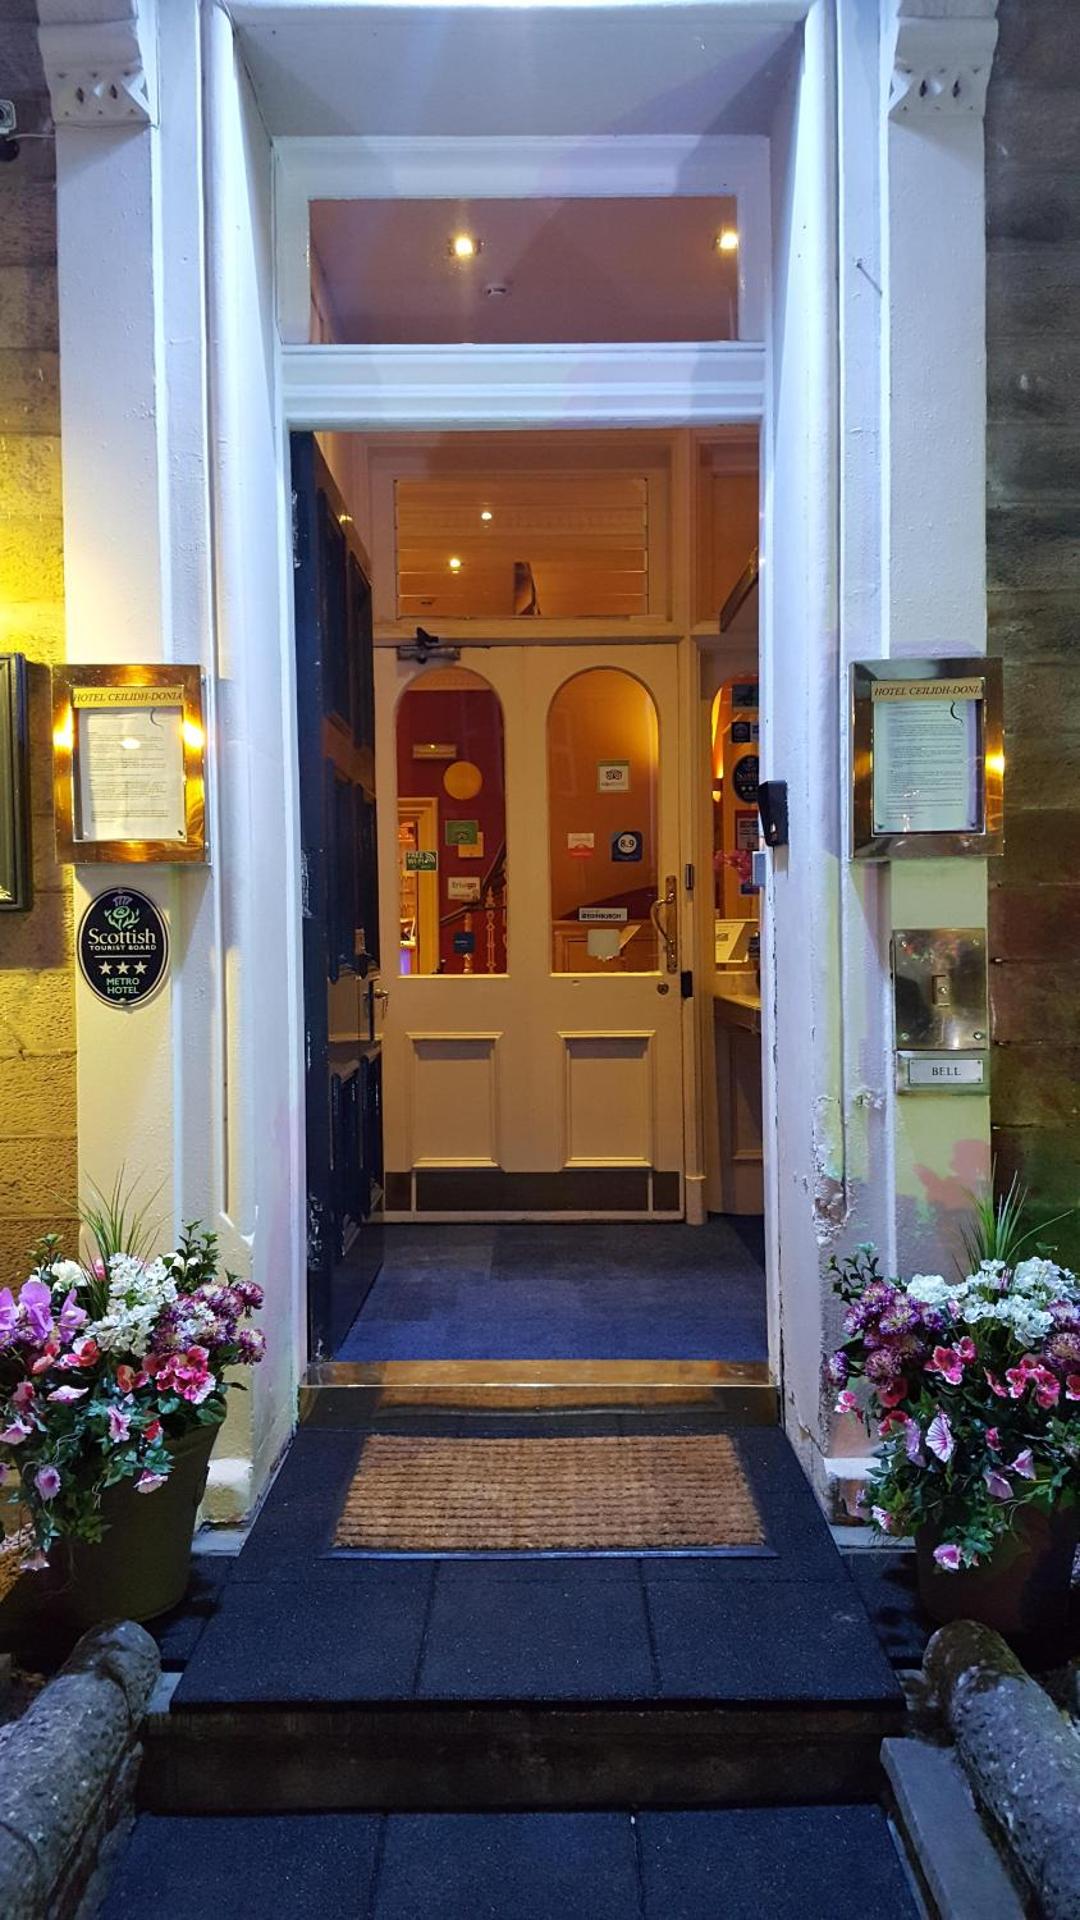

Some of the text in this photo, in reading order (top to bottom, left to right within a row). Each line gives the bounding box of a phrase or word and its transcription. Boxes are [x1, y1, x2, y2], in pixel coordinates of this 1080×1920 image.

[875, 687, 906, 697] HOTEL
[620, 838, 635, 849] 8.9
[87, 927, 156, 945] Scottish
[105, 976, 141, 986] METRO
[106, 986, 140, 994] HOTEL
[931, 1066, 962, 1077] BELL
